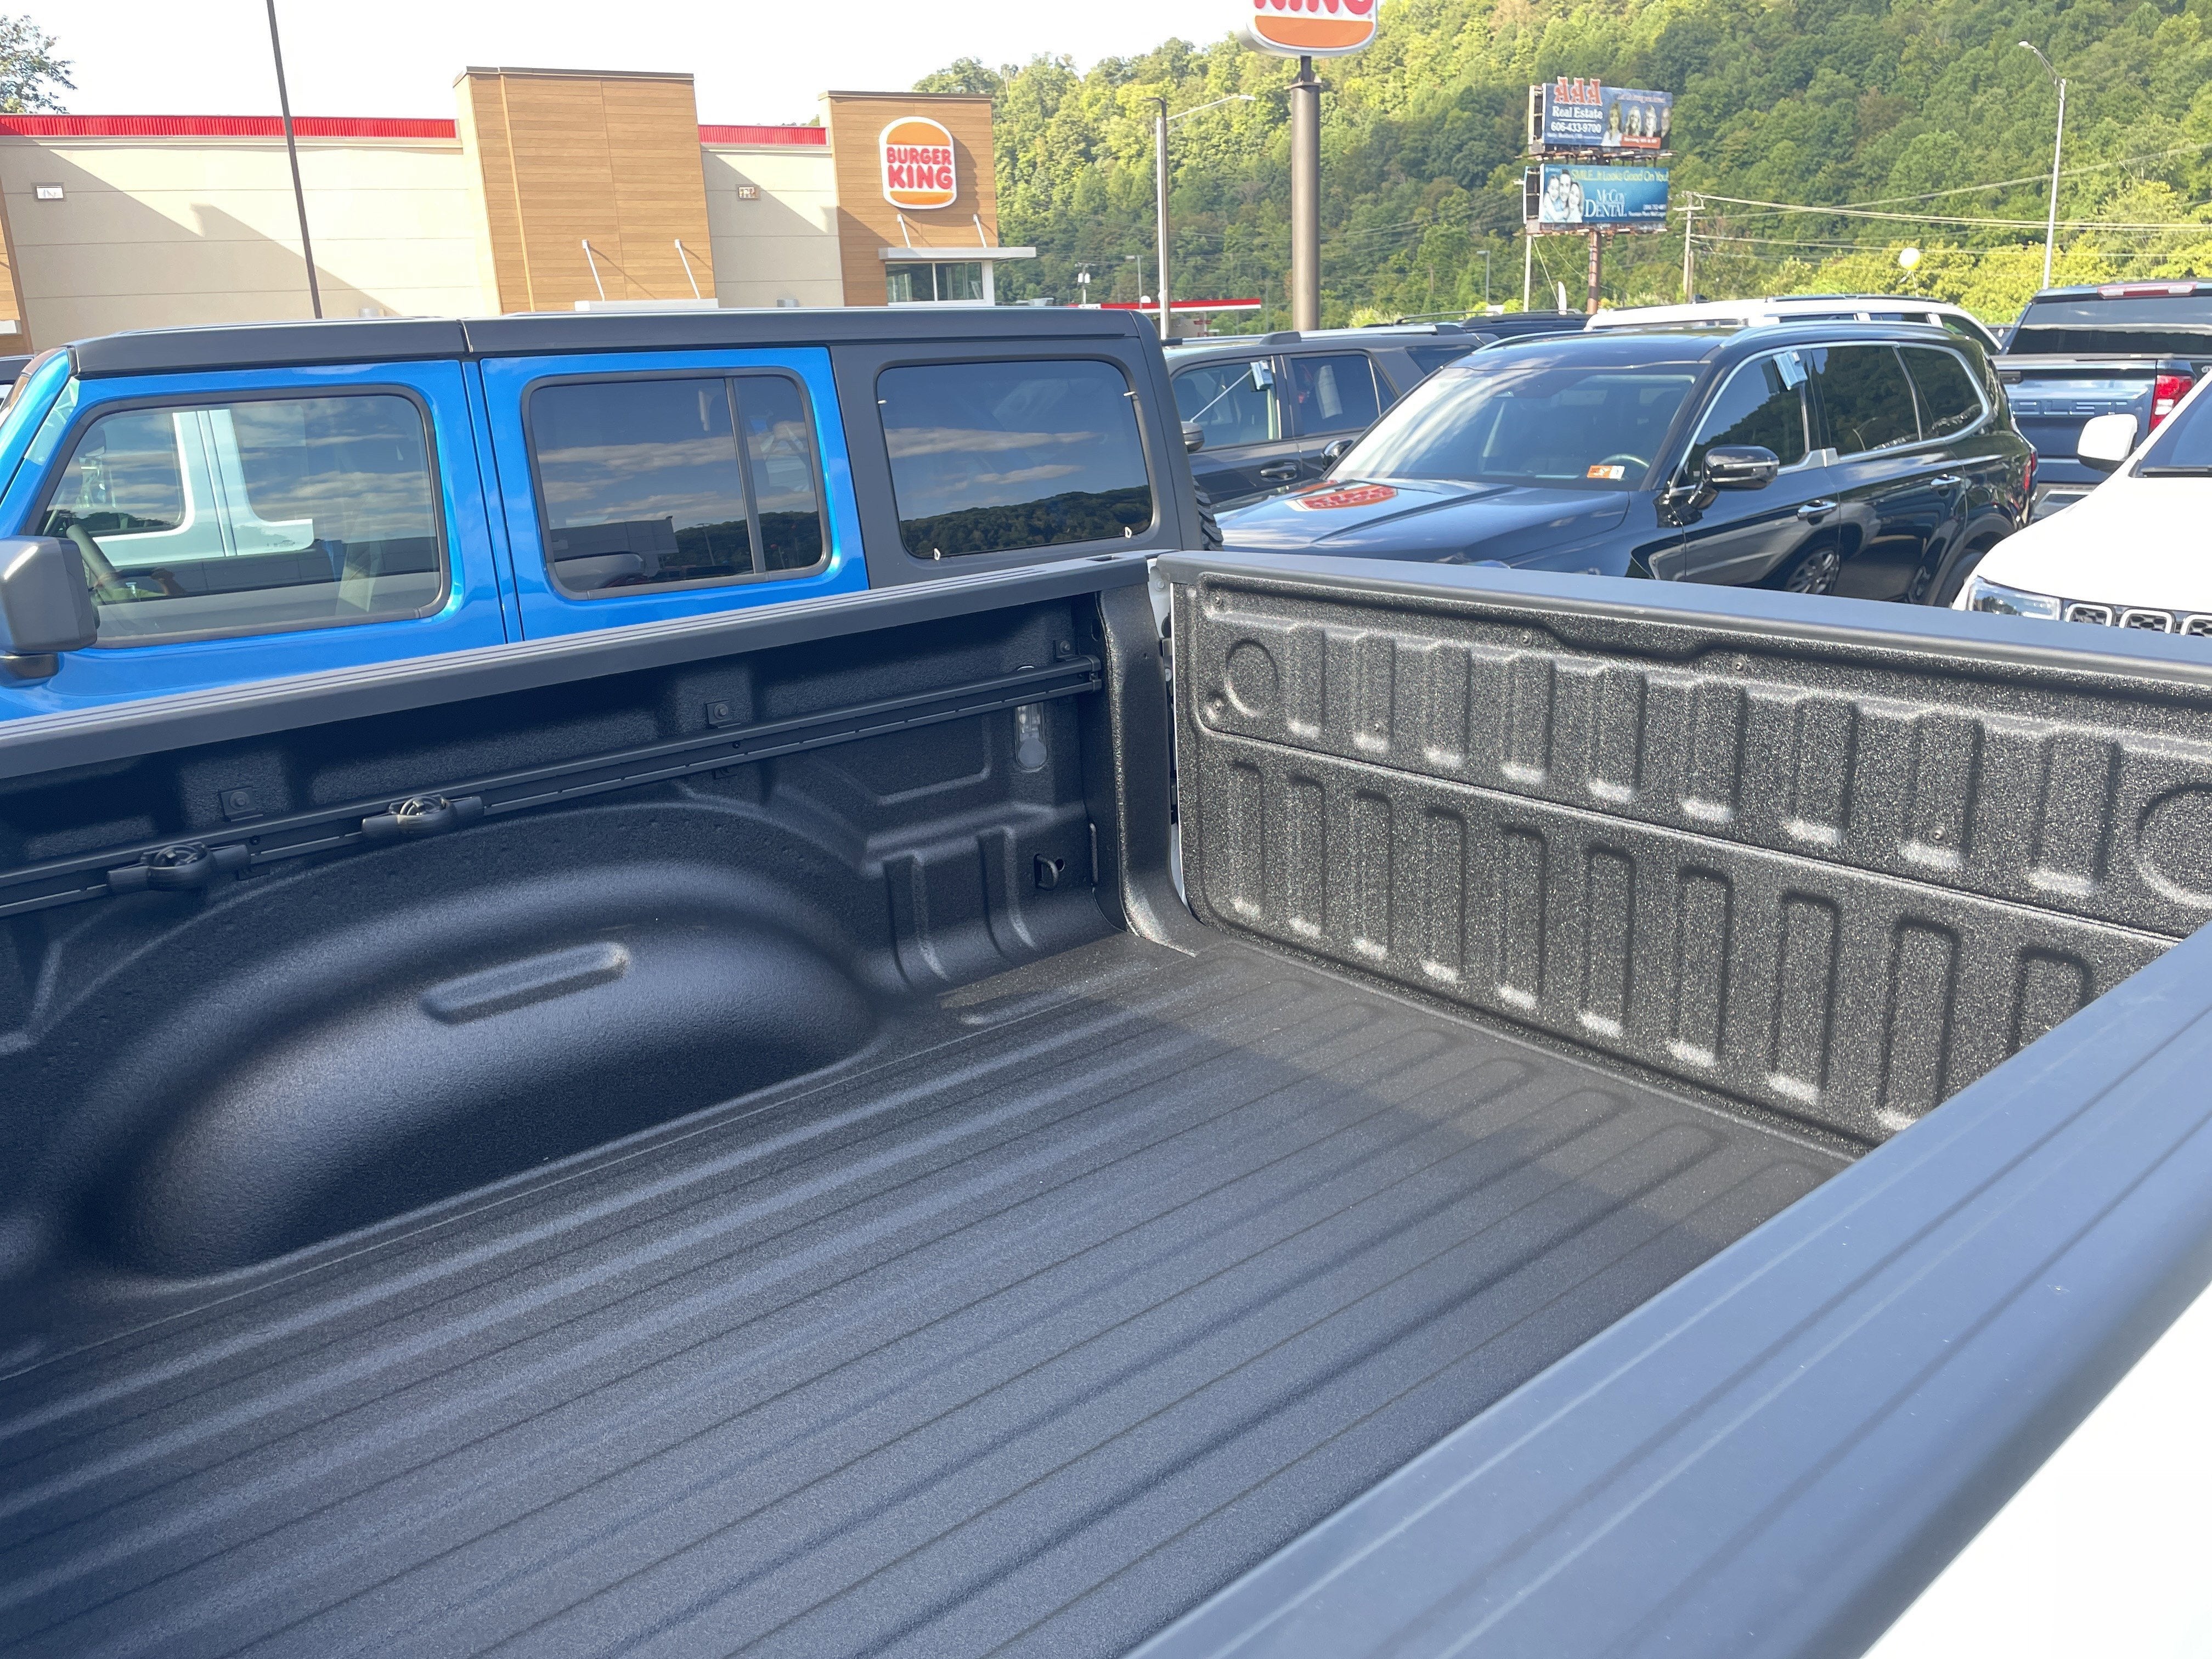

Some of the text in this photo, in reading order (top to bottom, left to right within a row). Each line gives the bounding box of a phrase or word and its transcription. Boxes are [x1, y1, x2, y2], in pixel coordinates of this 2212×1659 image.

[1552, 105, 1603, 119] Real Estate
[887, 147, 952, 165] BURGER
[888, 165, 953, 189] KING
[1623, 170, 1643, 181] Good
[1644, 171, 1655, 182] On
[1584, 199, 1627, 217] DENTAL
